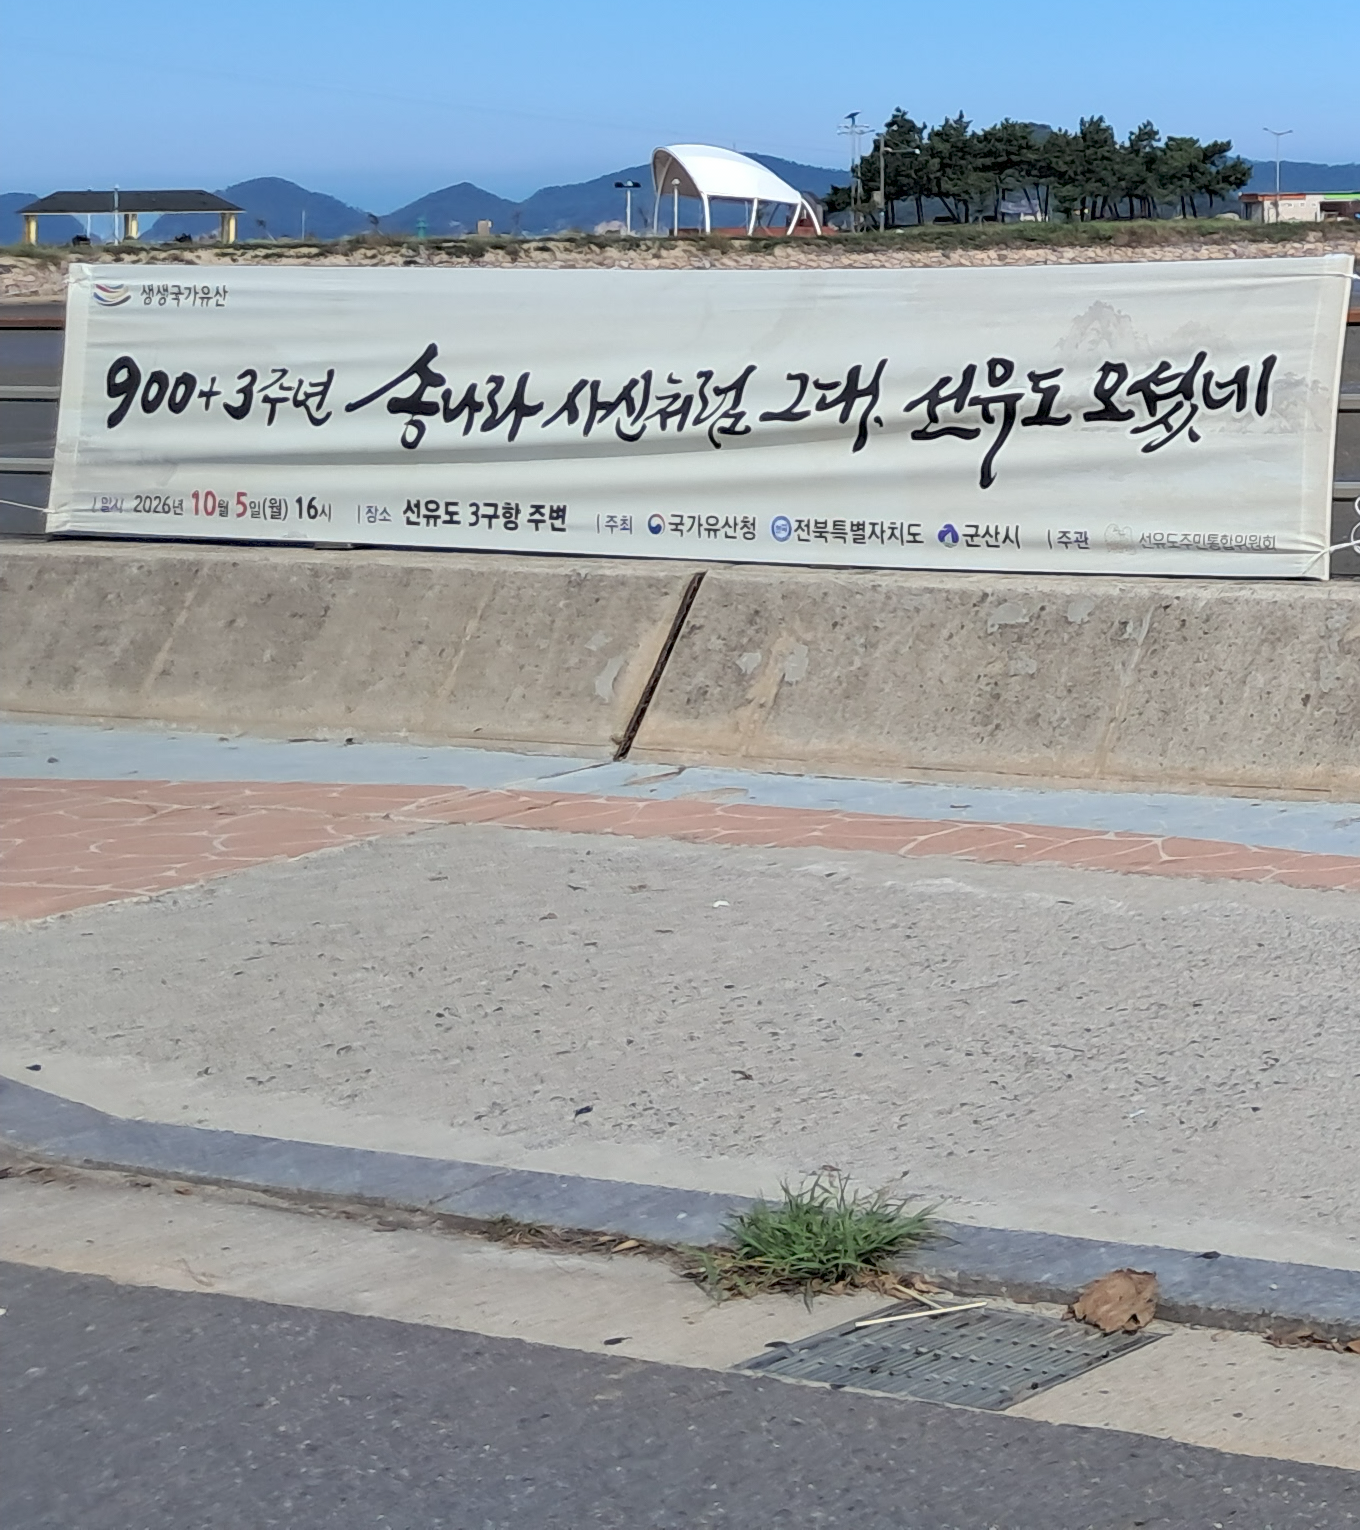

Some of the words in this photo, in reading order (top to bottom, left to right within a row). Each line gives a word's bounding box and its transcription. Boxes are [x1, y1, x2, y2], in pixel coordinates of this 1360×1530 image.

[140, 283, 229, 308] 생생국가유산
[345, 342, 544, 450] 송나라
[541, 364, 757, 450] 사신처럼
[903, 356, 1072, 489] 선유도
[1082, 350, 1278, 454] 오셨네
[101, 496, 124, 513] 일시
[133, 494, 184, 516] 2026년
[191, 489, 230, 518] 10월
[235, 491, 289, 521] 5일(월)
[295, 495, 332, 523] 16시
[365, 504, 392, 524] 장소
[402, 498, 462, 527] 선유도
[468, 502, 521, 532] 3구항
[527, 504, 568, 533] 주변
[604, 514, 633, 535] 주최
[668, 513, 757, 541] 국가유산청
[793, 517, 925, 546] 전북특별자치도
[962, 524, 1021, 550] 군산시
[1056, 530, 1090, 551] 주관
